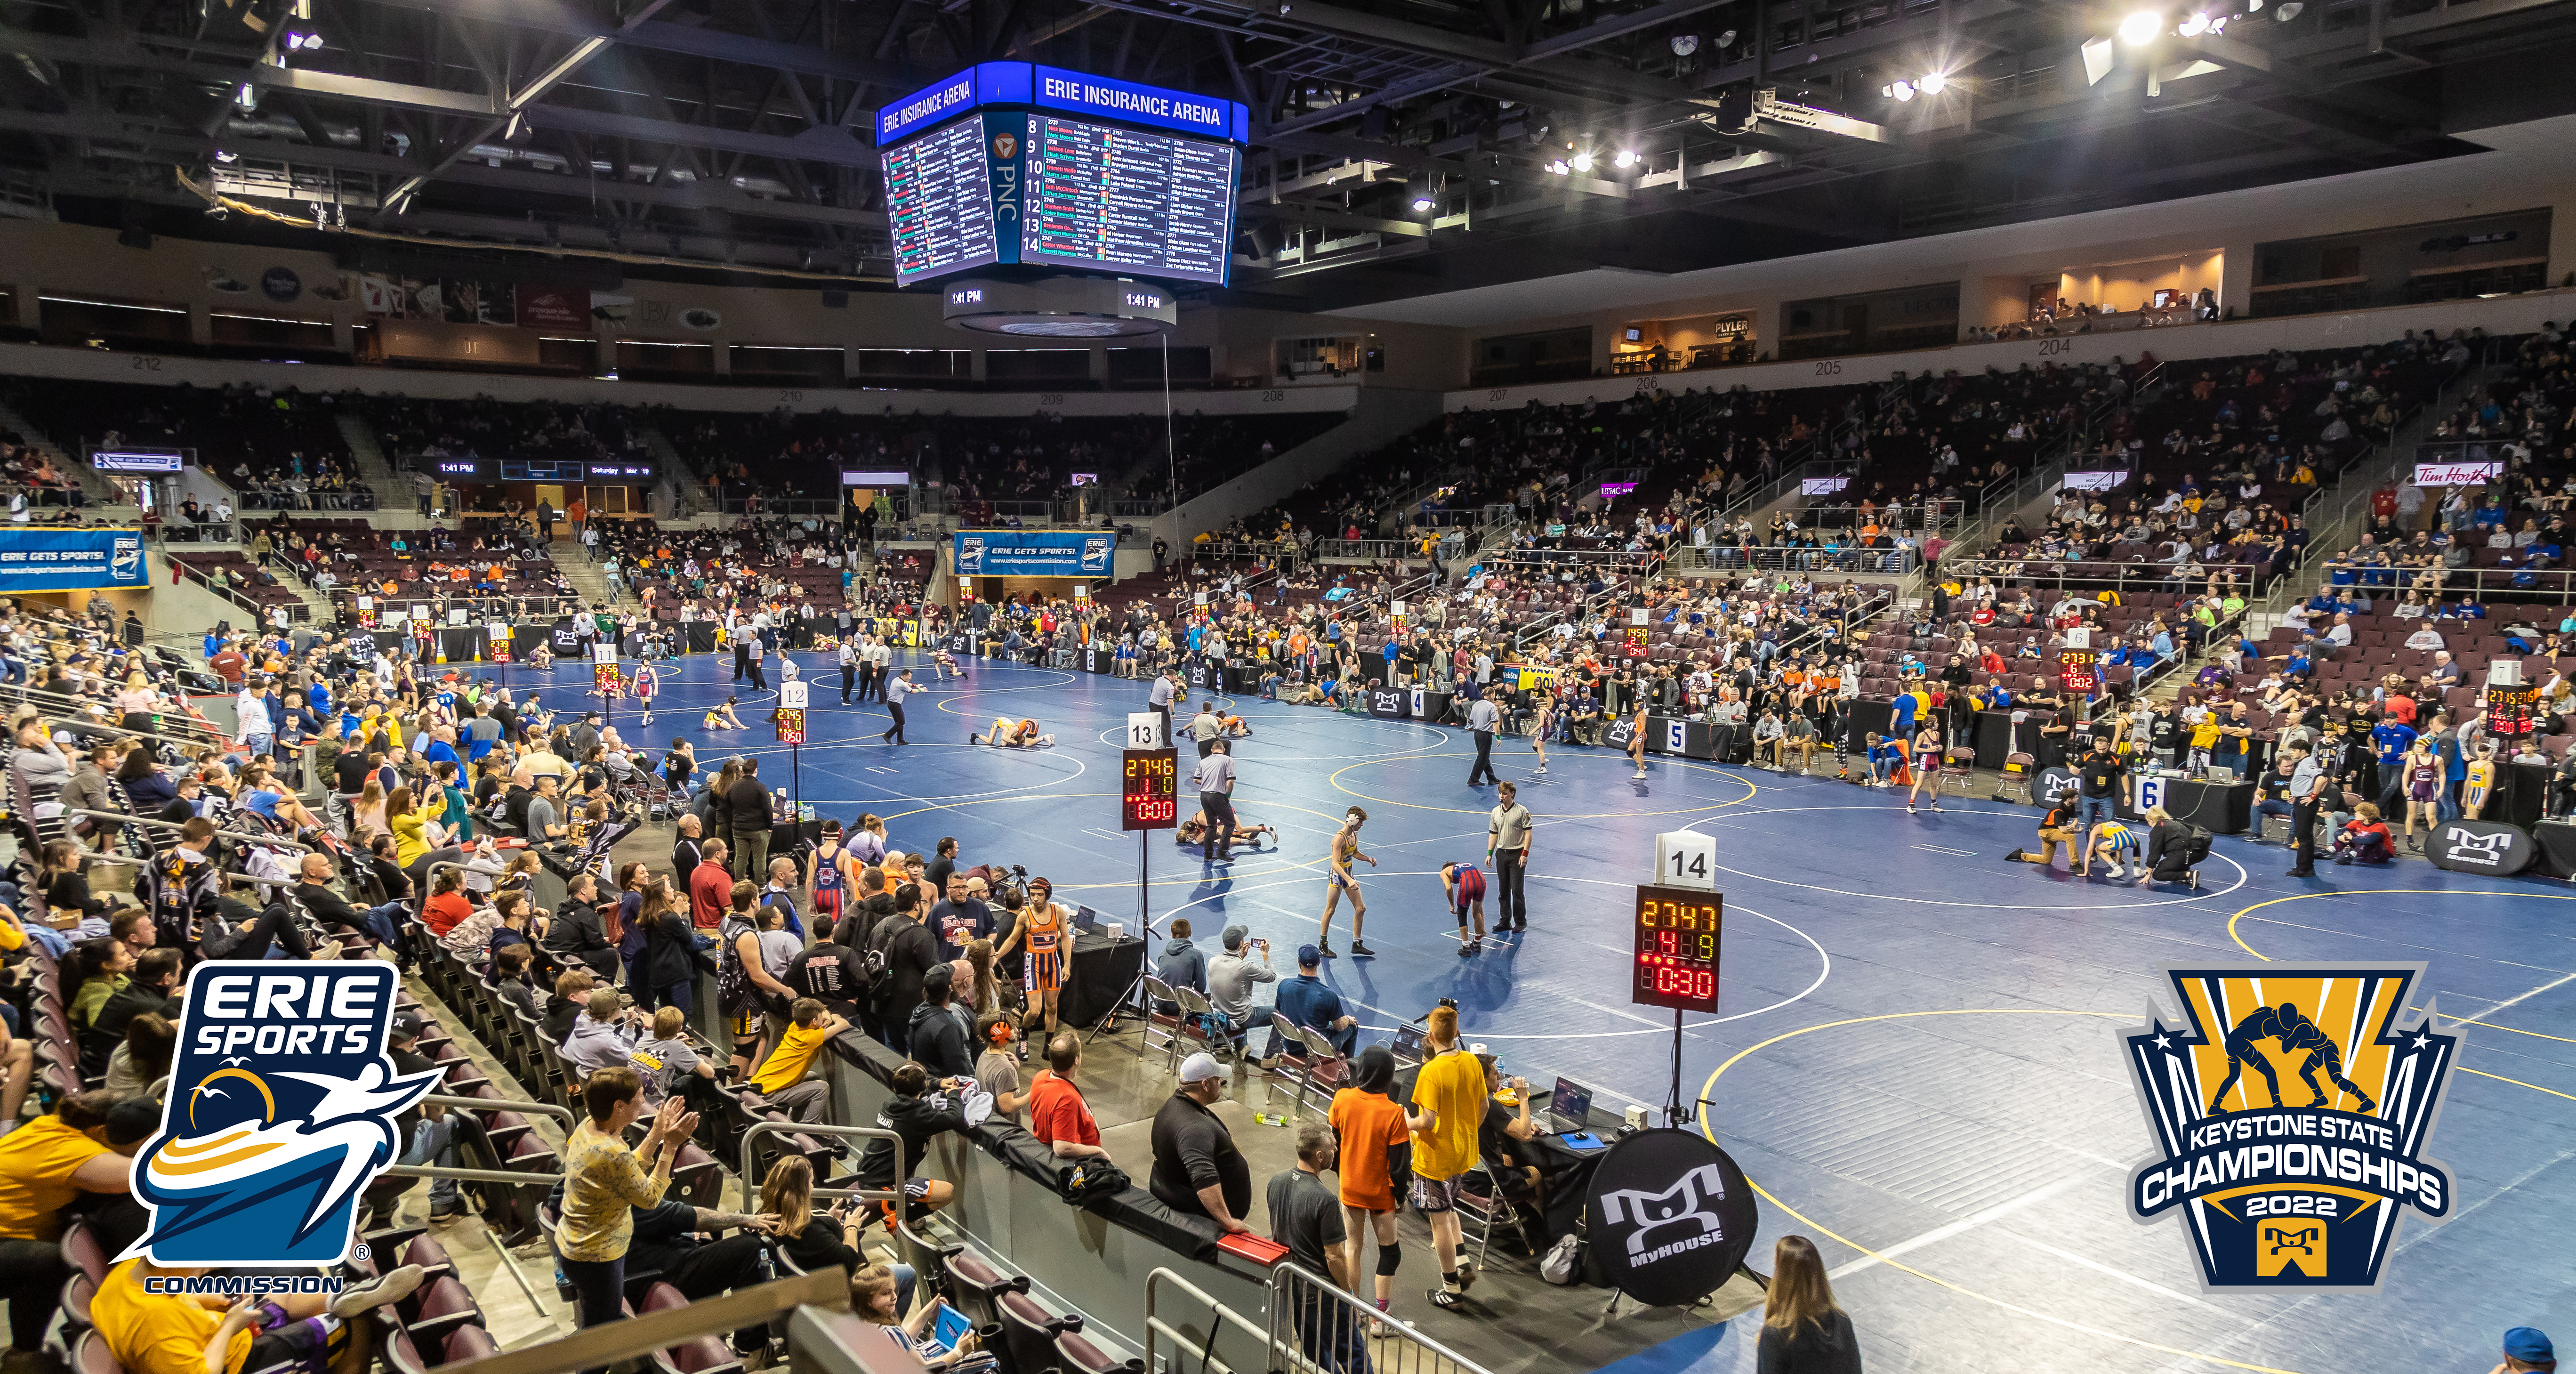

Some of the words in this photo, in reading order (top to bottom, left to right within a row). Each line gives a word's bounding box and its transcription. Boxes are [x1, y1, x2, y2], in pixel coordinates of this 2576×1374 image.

[884, 111, 899, 133] ERIE
[901, 93, 942, 125] INSURANCE
[943, 81, 970, 107] ARENA
[1046, 78, 1079, 100] ERIE
[1085, 85, 1168, 116] INSURANCE
[1173, 102, 1220, 126] ARENA
[1029, 120, 1037, 134] 8
[1028, 140, 1036, 153] 9
[883, 159, 887, 171] 8
[1027, 159, 1042, 174] 10
[885, 176, 889, 189] 9
[1026, 179, 1040, 194] 11
[997, 163, 1016, 221] PNC
[887, 193, 895, 206] 10
[1025, 199, 1040, 213] 12
[889, 210, 897, 224] 11
[1024, 218, 1039, 232] 13
[891, 228, 900, 241] 12
[1023, 237, 1038, 251] 14
[894, 245, 902, 259] 13
[896, 263, 904, 276] 14
[952, 291, 965, 305] 1:41
[967, 290, 981, 303] PM
[1126, 293, 1144, 306] 1:41
[1148, 296, 1160, 309] PM
[1716, 321, 1748, 333] PLYLER
[2039, 339, 2072, 356] 204
[133, 356, 161, 371] 212
[1815, 361, 1841, 376] 205
[1636, 377, 1657, 389] 206
[781, 390, 803, 401] 210
[1041, 394, 1063, 405] 209
[1263, 390, 1283, 402] 208
[1489, 390, 1506, 401] 207
[441, 464, 458, 472] 1:41
[460, 464, 474, 472] PM
[2419, 468, 2442, 482] Tim
[117, 541, 137, 549] ERIE
[1, 552, 27, 561] ERIE
[29, 552, 58, 560] GETS
[60, 551, 105, 560] SPORTS!
[1637, 613, 1642, 622] 5
[493, 628, 505, 637] 10
[1628, 629, 1647, 637] 1450
[2075, 632, 2082, 643] 6
[599, 650, 612, 660] 11
[1089, 653, 1093, 667] 2
[2062, 653, 2093, 664] 2731
[596, 664, 618, 673] 2756
[2070, 663, 2077, 673] 6
[2499, 666, 2505, 679] 7
[2069, 678, 2093, 688] 0:02
[786, 689, 804, 703] 12
[1414, 693, 1421, 712] 4
[778, 709, 801, 720] 2745
[2496, 703, 2503, 714] 2
[784, 720, 789, 728] 4
[795, 721, 801, 730] 0
[1132, 725, 1151, 744] 13
[1155, 723, 1161, 742] 13
[1671, 725, 1682, 747] 5
[1126, 758, 1173, 777] 2746
[1163, 777, 1173, 793] 0
[2142, 782, 2157, 808] 6
[1138, 801, 1173, 820] 0:00
[1671, 850, 1707, 880] 14
[1642, 900, 1716, 931] 2747
[1660, 931, 1676, 954] 4
[1699, 935, 1714, 960] 9
[1658, 966, 1712, 997] 0:30
[1630, 1229, 1724, 1268] MyHOUSE
